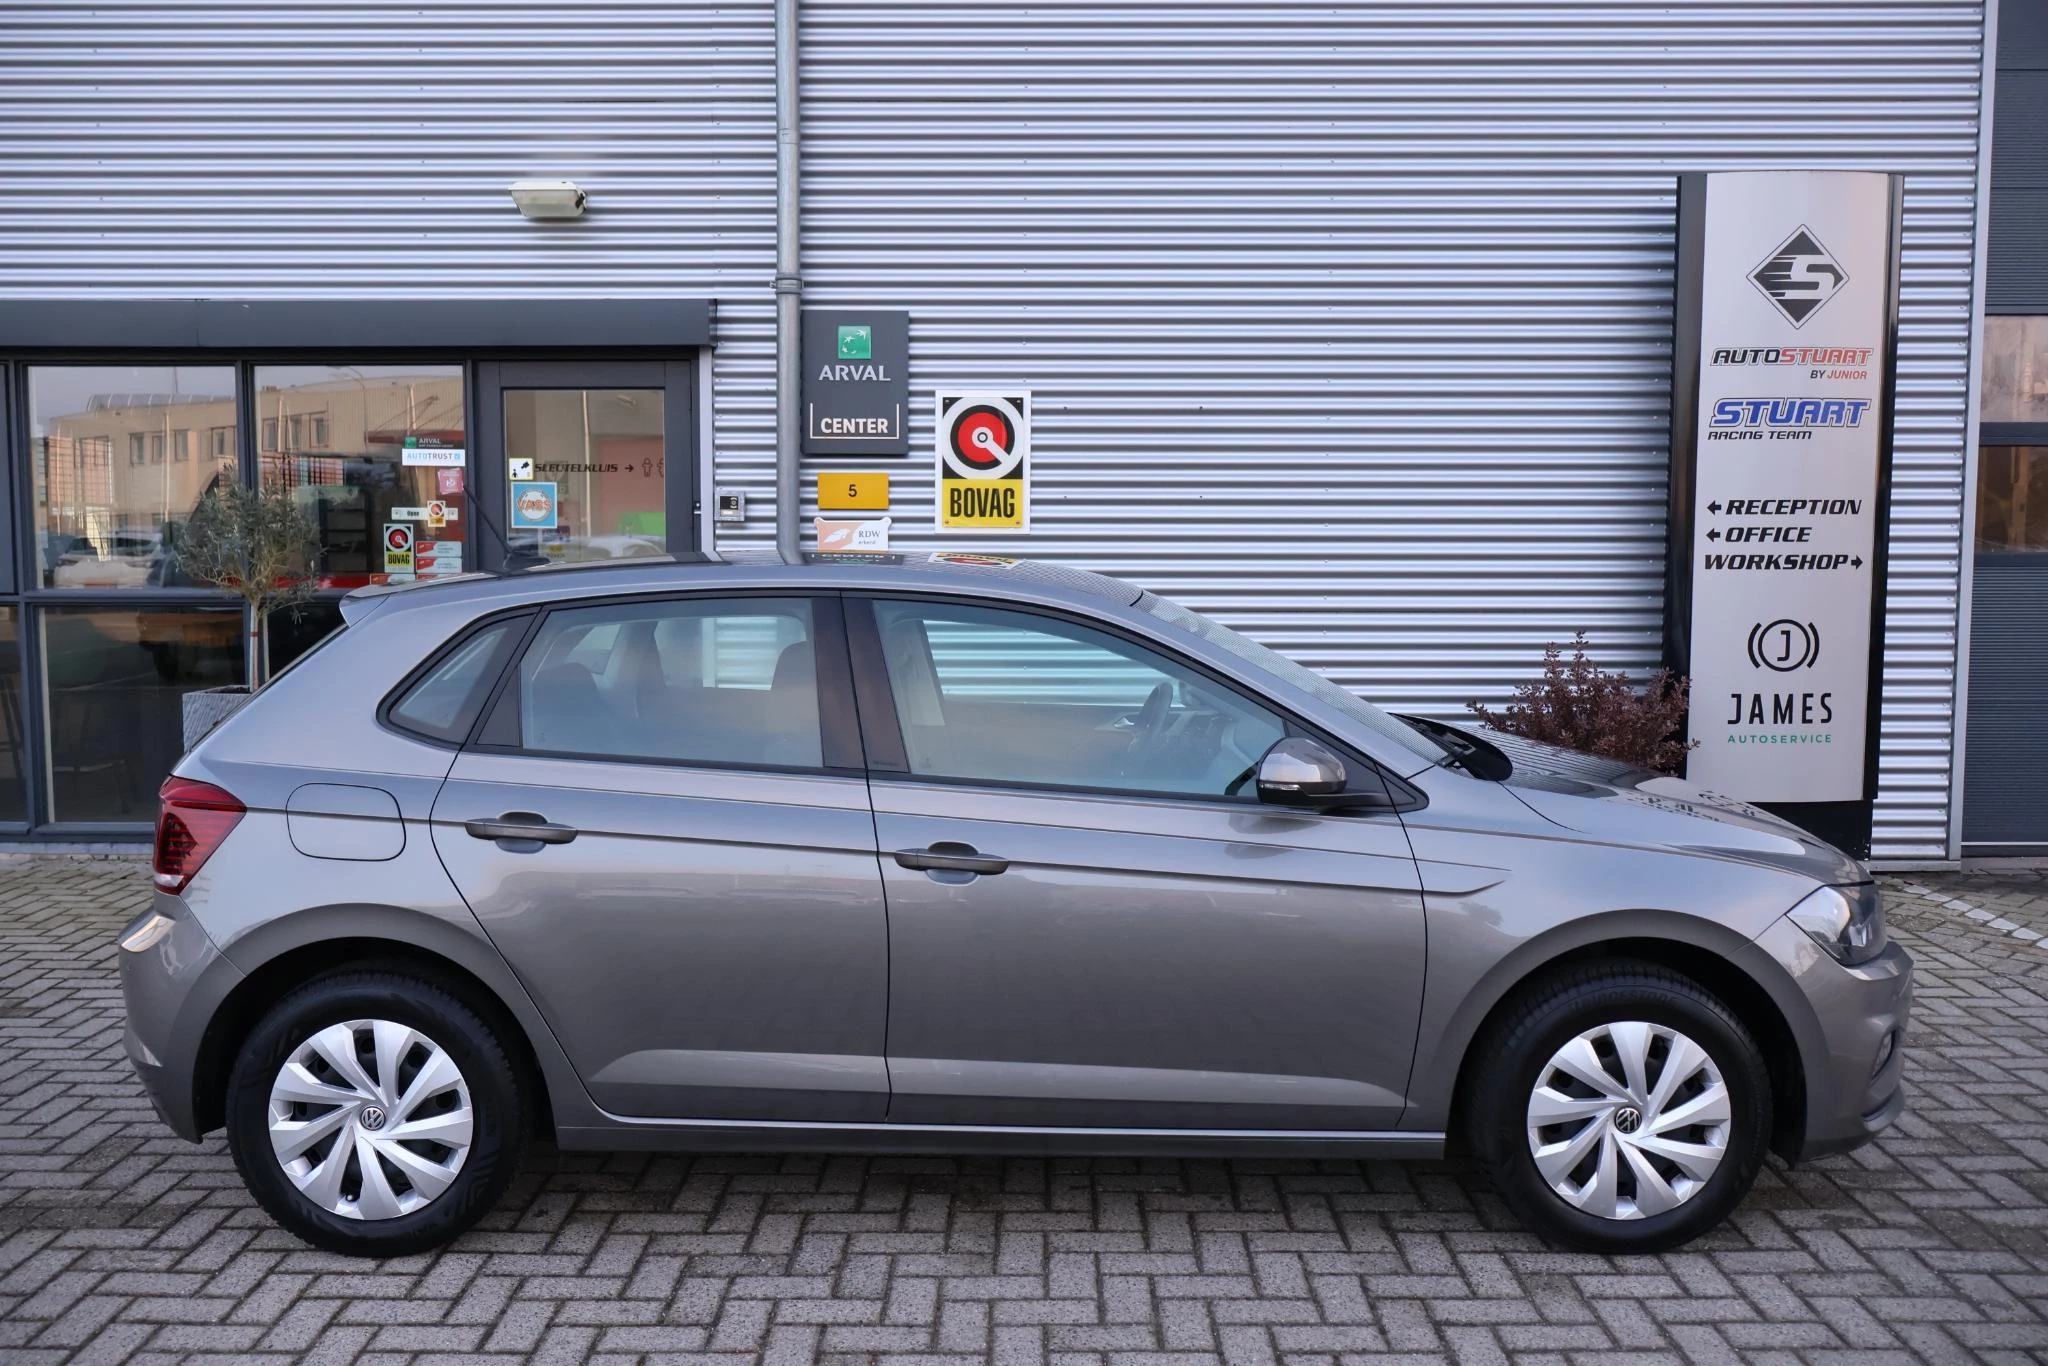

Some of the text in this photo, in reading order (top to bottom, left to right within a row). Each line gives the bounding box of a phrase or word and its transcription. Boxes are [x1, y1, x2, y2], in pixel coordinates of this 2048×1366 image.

[1712, 347, 1873, 365] AUTOSTUART
[818, 365, 891, 381] ARVAL
[1810, 370, 1868, 380] BY JUNIOR
[1711, 398, 1871, 427] STUART
[820, 418, 889, 434] CENTER
[1708, 431, 1812, 440] RACING TEAM
[407, 452, 453, 460] AUTOTRUST
[848, 484, 858, 498] 5
[950, 487, 1015, 518] BOVAG
[1725, 499, 1862, 515] RECEPTION
[858, 530, 881, 538] RDW
[1725, 526, 1812, 543] OFFICE
[388, 554, 410, 565] BOVAG
[1704, 554, 1849, 570] WORKSHOP
[1727, 692, 1833, 725] JAMES
[1727, 734, 1832, 744] AUTOSERVICE
